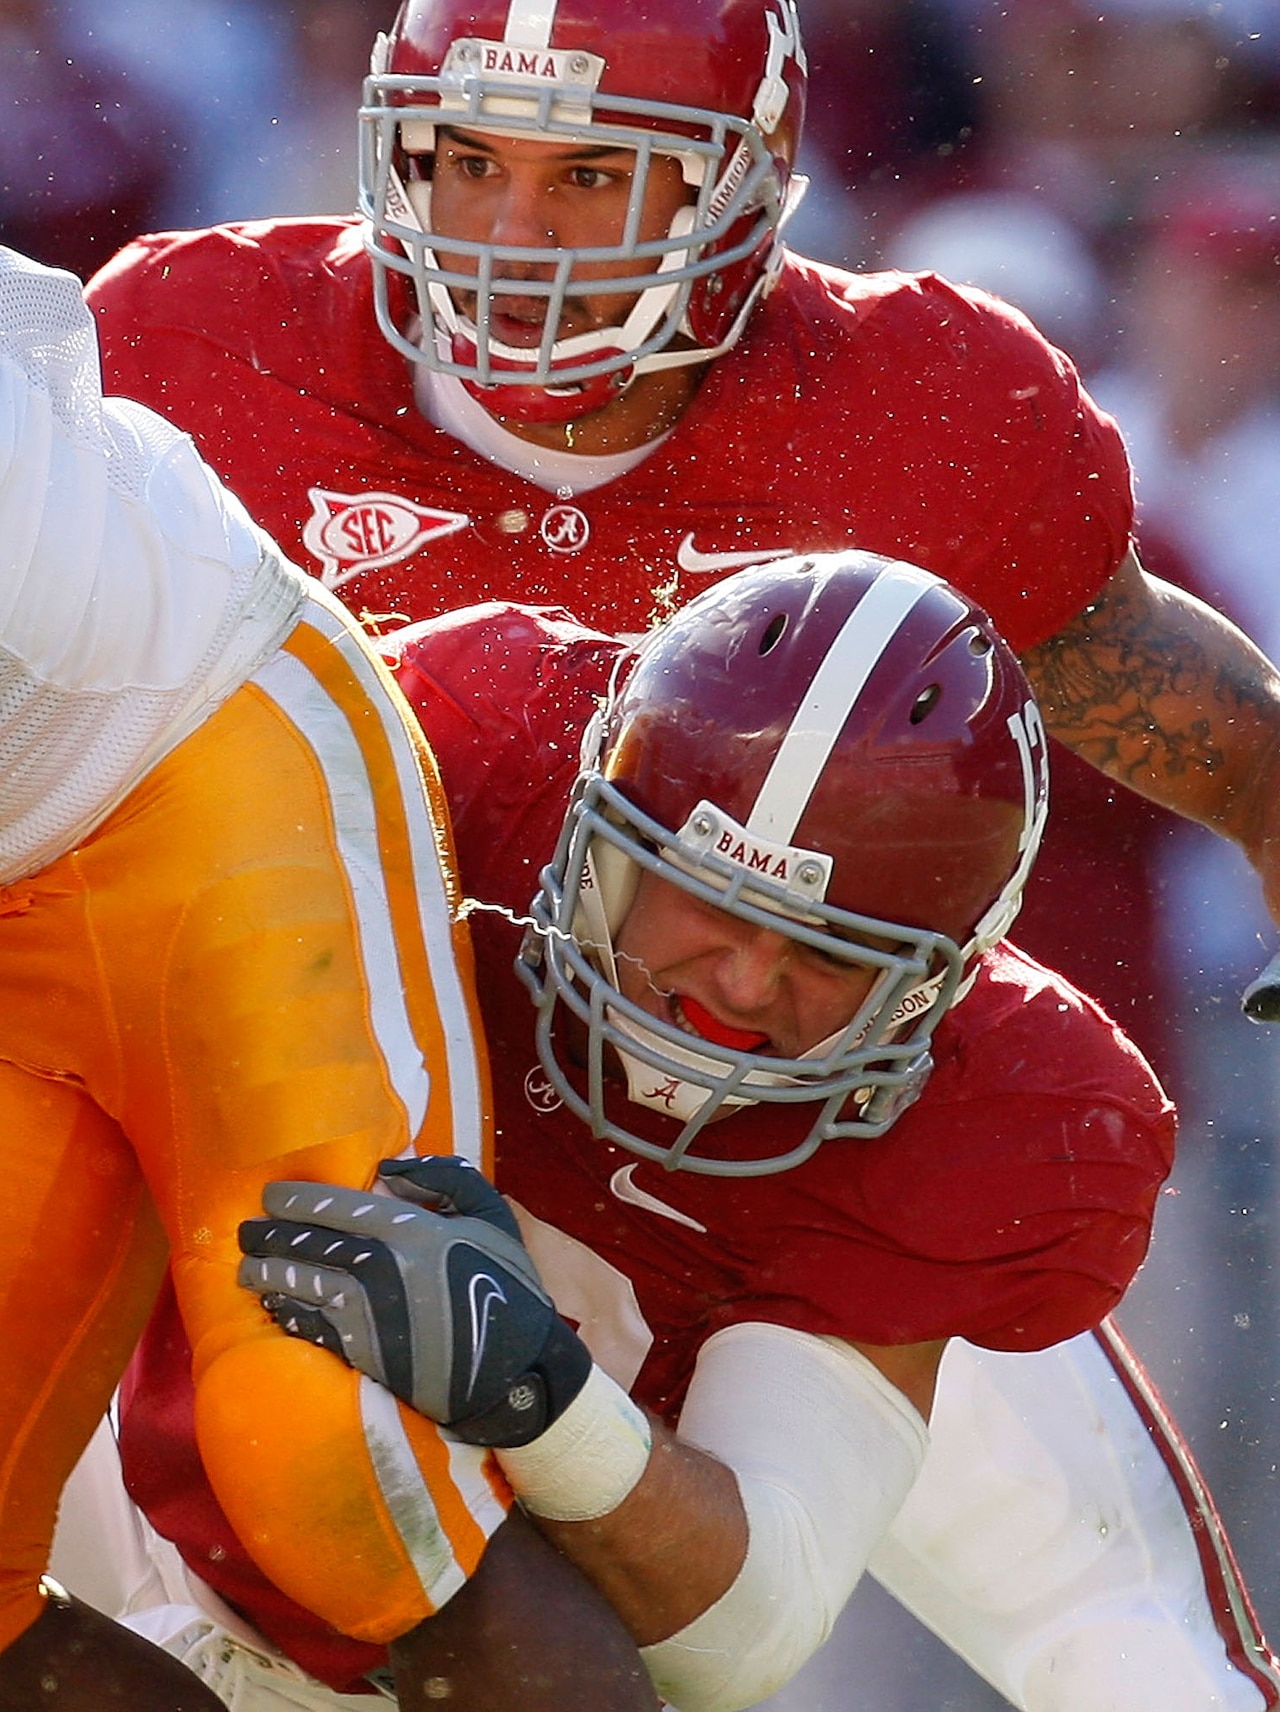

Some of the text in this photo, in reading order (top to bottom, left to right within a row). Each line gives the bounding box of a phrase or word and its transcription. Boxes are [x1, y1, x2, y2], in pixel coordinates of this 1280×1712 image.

[485, 49, 557, 79] BAMA
[341, 507, 396, 557] SEC
[716, 830, 788, 880] BAMA
